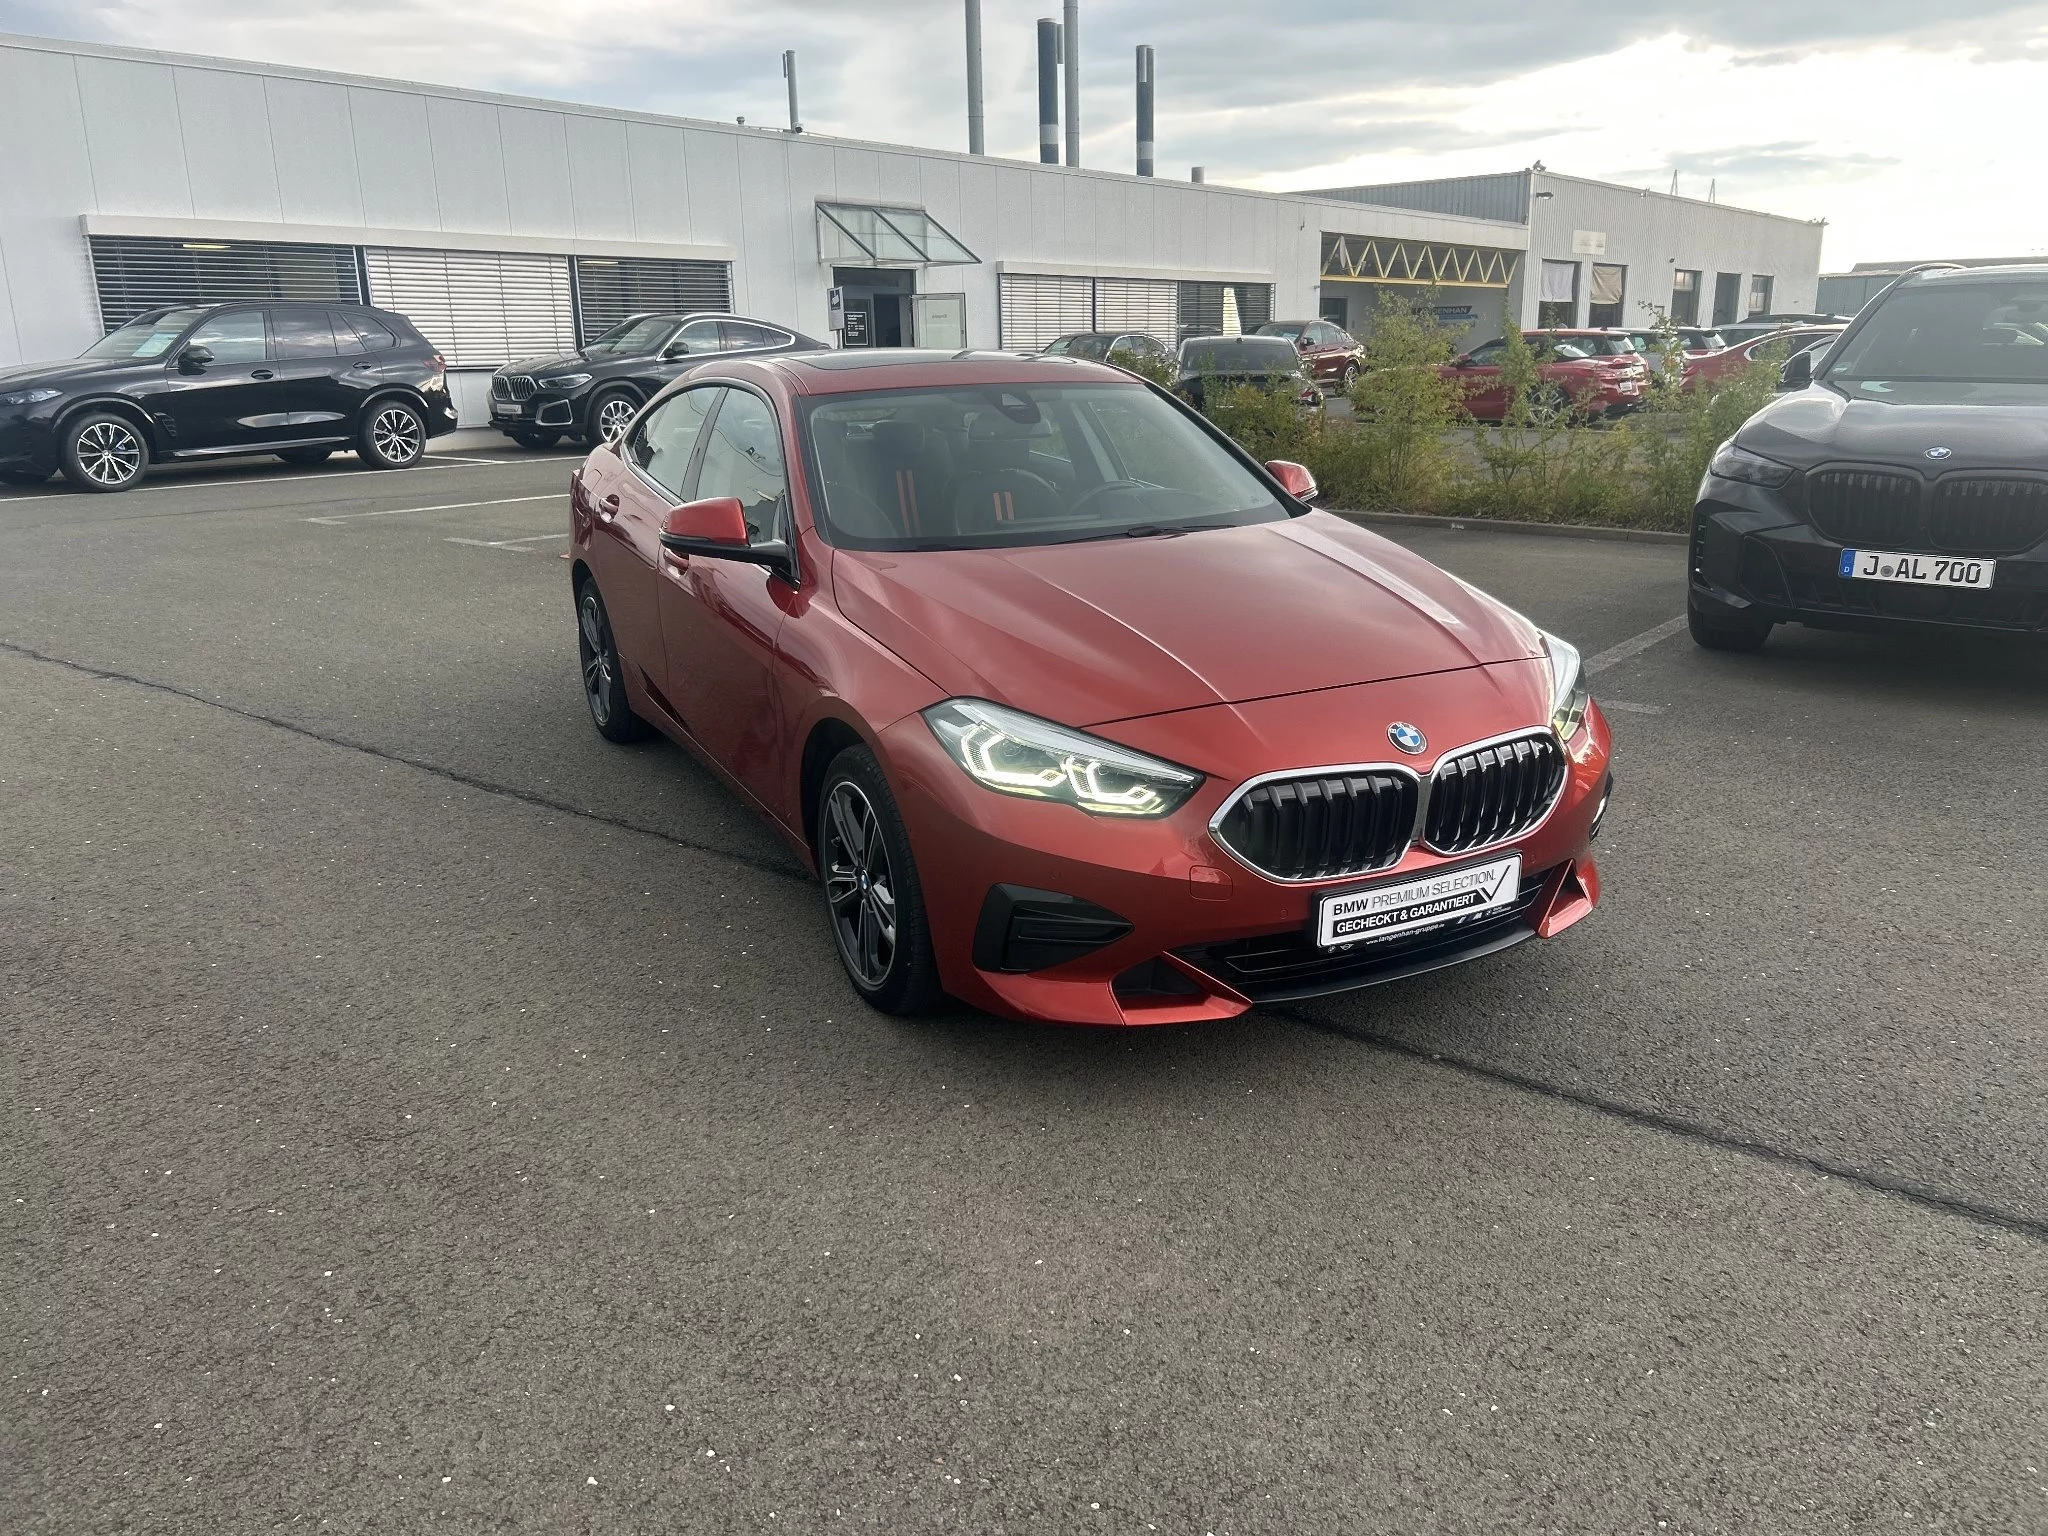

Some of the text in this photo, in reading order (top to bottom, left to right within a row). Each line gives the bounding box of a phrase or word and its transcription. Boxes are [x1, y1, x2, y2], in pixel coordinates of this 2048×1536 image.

[1863, 555, 1982, 584] J AL 700
[1333, 898, 1369, 916] BMW
[1372, 886, 1430, 909] PREMIUM
[1336, 911, 1399, 933] GECHECKT
[1400, 910, 1408, 920] &
[1409, 893, 1477, 918] GARANTIERT
